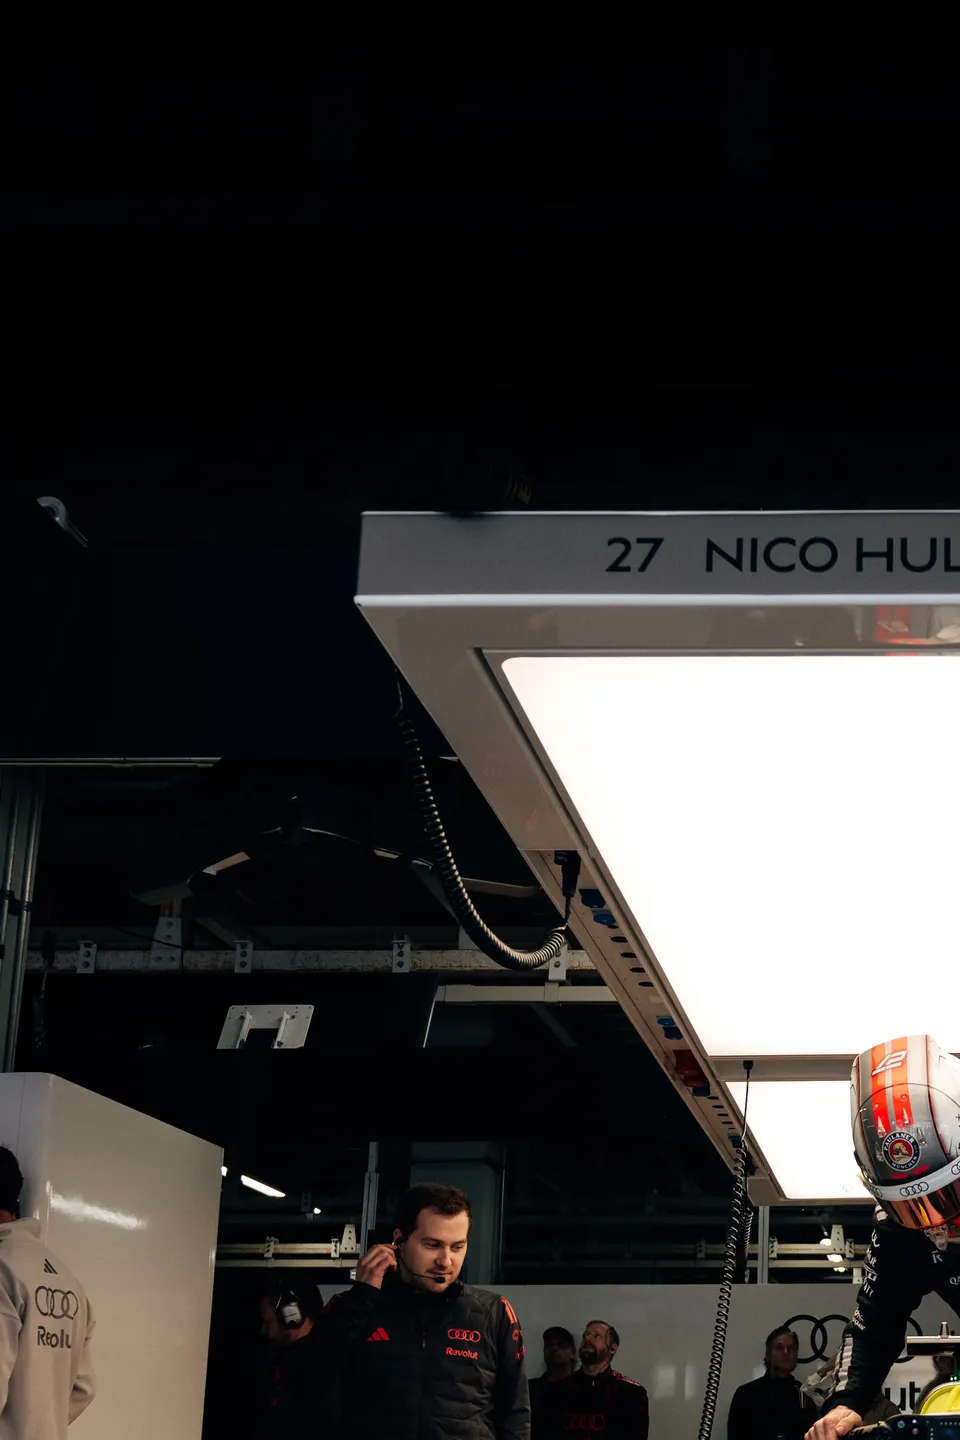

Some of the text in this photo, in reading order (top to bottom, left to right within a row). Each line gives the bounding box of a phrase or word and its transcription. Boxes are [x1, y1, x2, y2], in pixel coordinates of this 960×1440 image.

[606, 536, 664, 572] 27
[706, 536, 838, 573] NICO
[884, 1133, 914, 1151] PAULANER
[445, 1345, 480, 1360] Revolut
